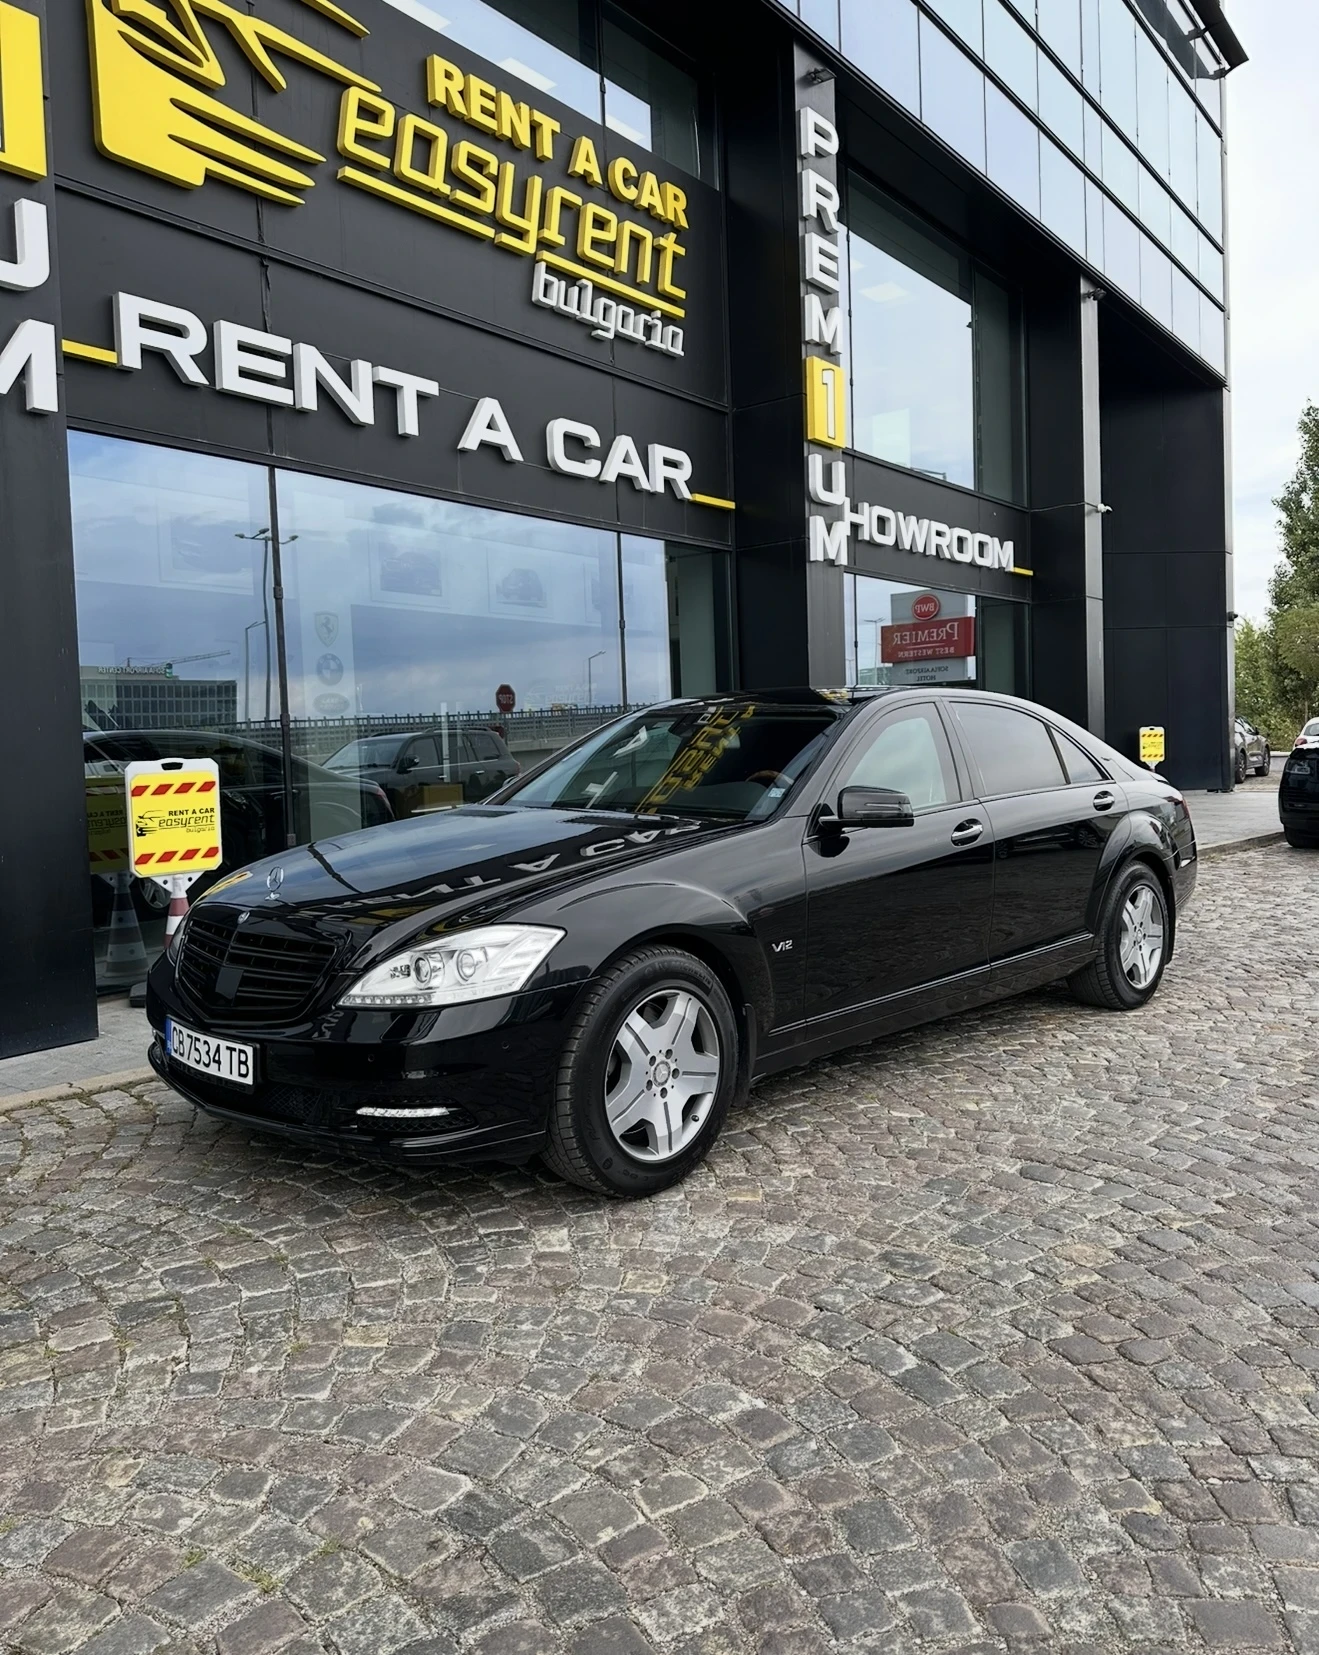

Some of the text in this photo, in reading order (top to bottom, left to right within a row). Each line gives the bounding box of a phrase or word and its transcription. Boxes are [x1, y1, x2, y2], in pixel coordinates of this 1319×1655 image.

[426, 53, 689, 230] RENT A CAR
[337, 86, 687, 299] easyrent
[531, 261, 685, 357] bulgaria
[113, 291, 692, 500] RENT A CAR
[844, 497, 1014, 572] HOWROOM
[158, 815, 215, 828] easyrent
[186, 826, 215, 834] bulgaria
[771, 940, 793, 952] V12
[225, 1045, 250, 1079] TB
